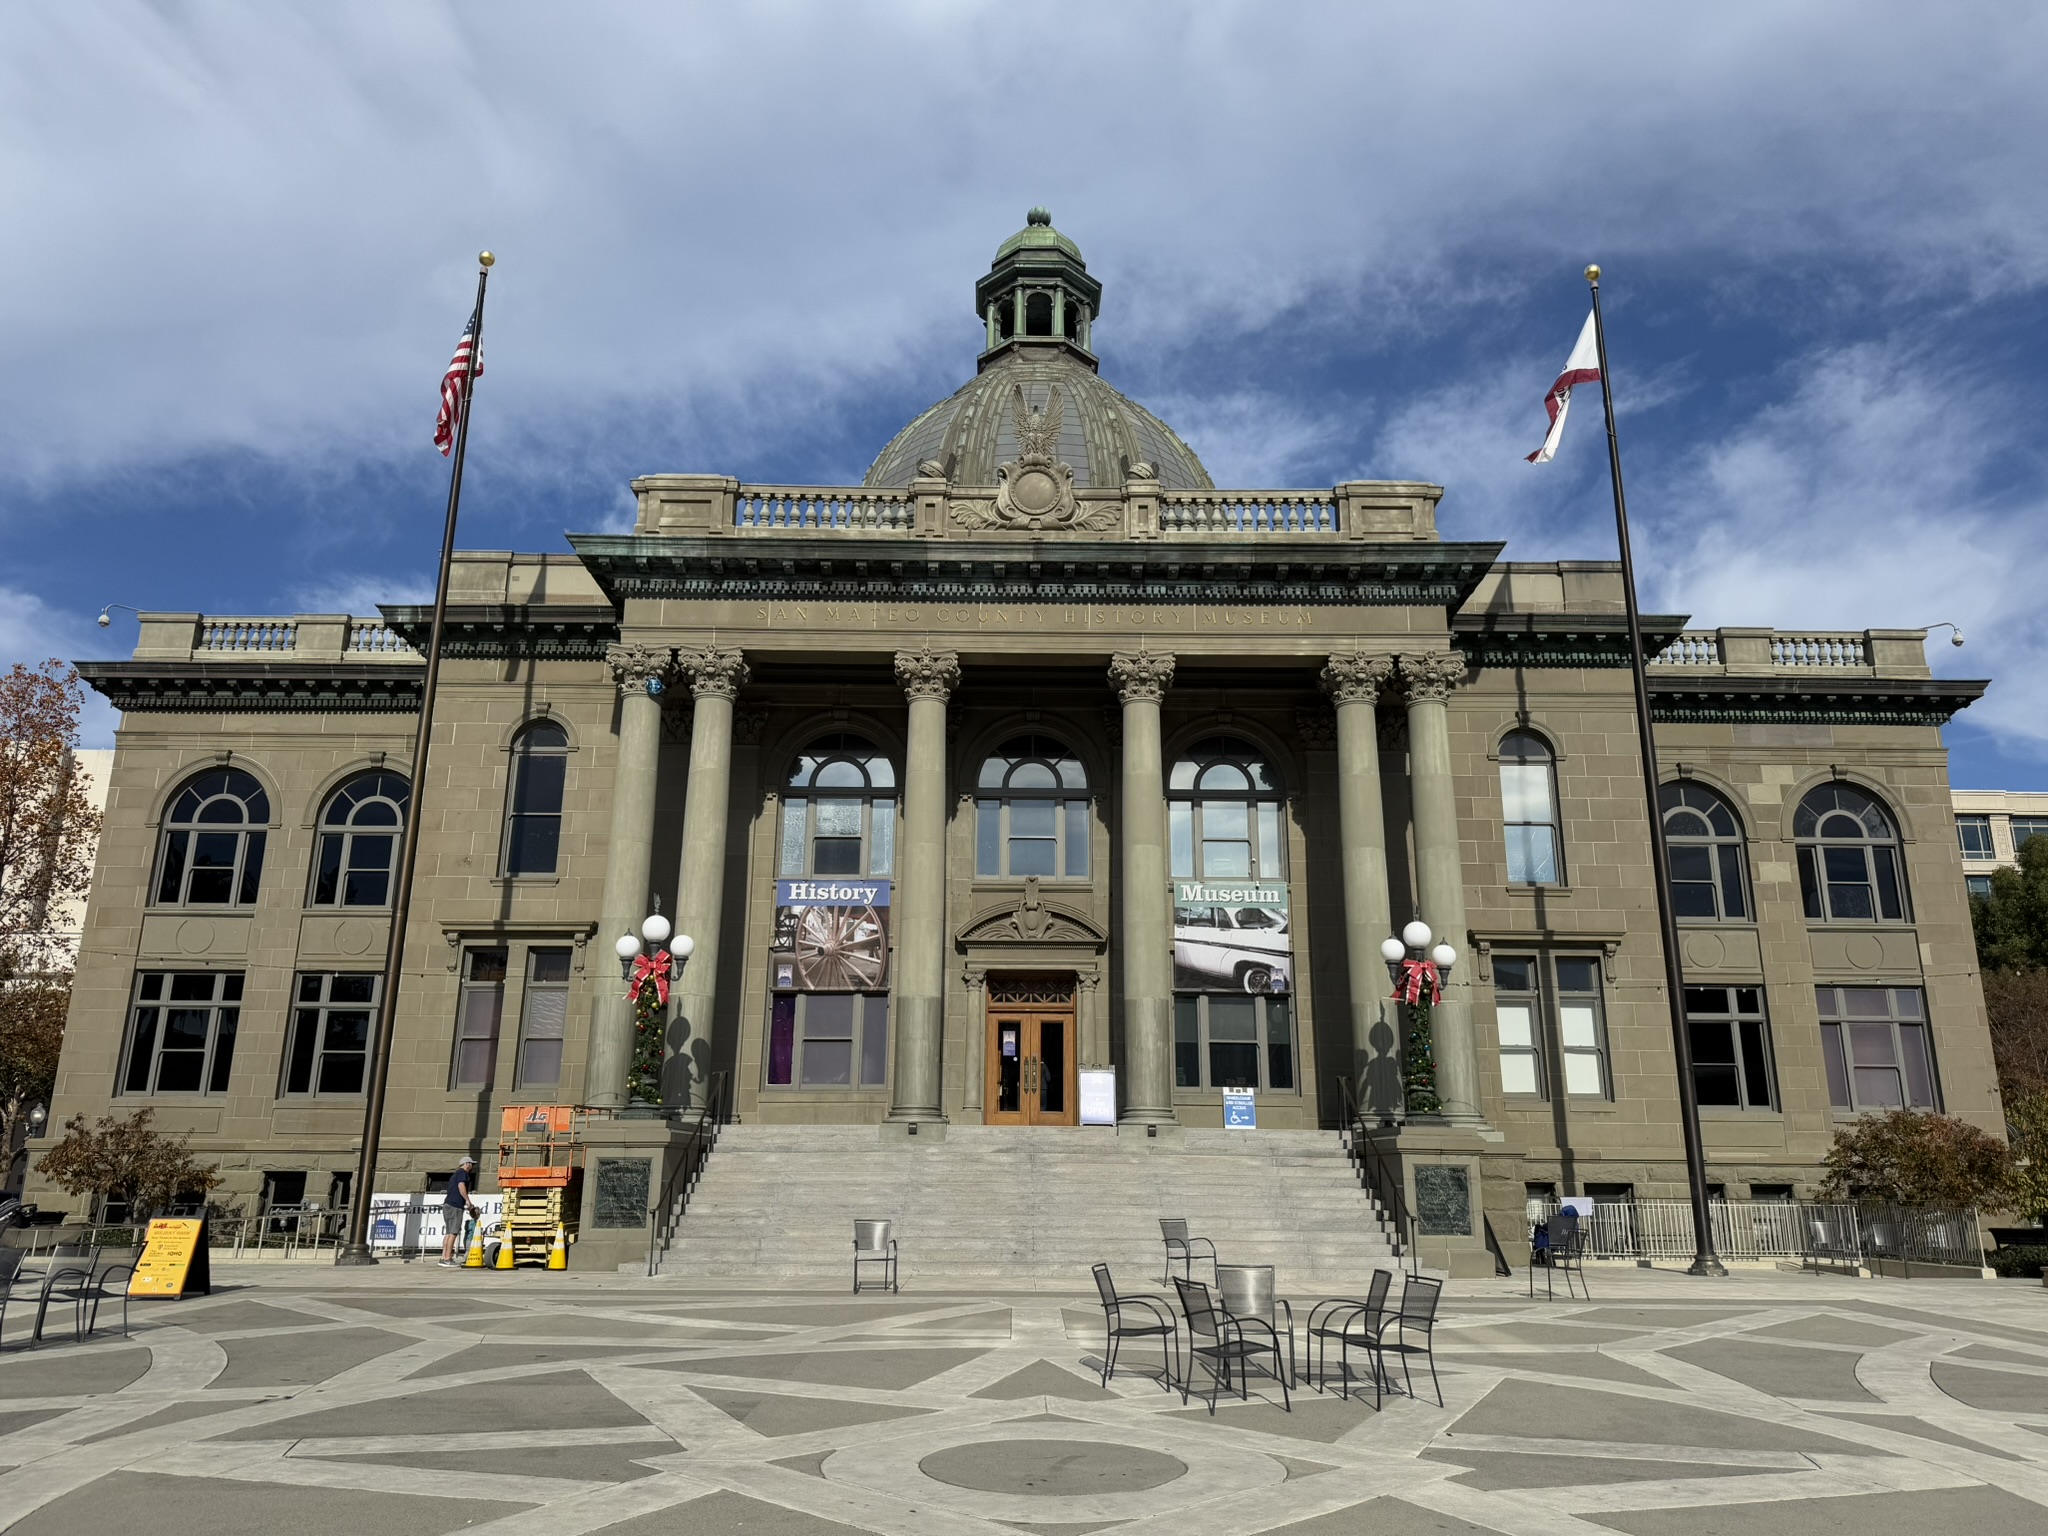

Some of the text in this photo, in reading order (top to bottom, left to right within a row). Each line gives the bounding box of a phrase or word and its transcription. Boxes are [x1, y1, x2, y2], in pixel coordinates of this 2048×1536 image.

[757, 606, 1313, 625] SAN MATEO COUNTY HISTORY MUSEUM
[788, 883, 878, 905] History
[1181, 884, 1281, 903] Museum
[524, 1109, 548, 1121] JLG
[1086, 1107, 1109, 1115] OPEN
[419, 1227, 435, 1235] on
